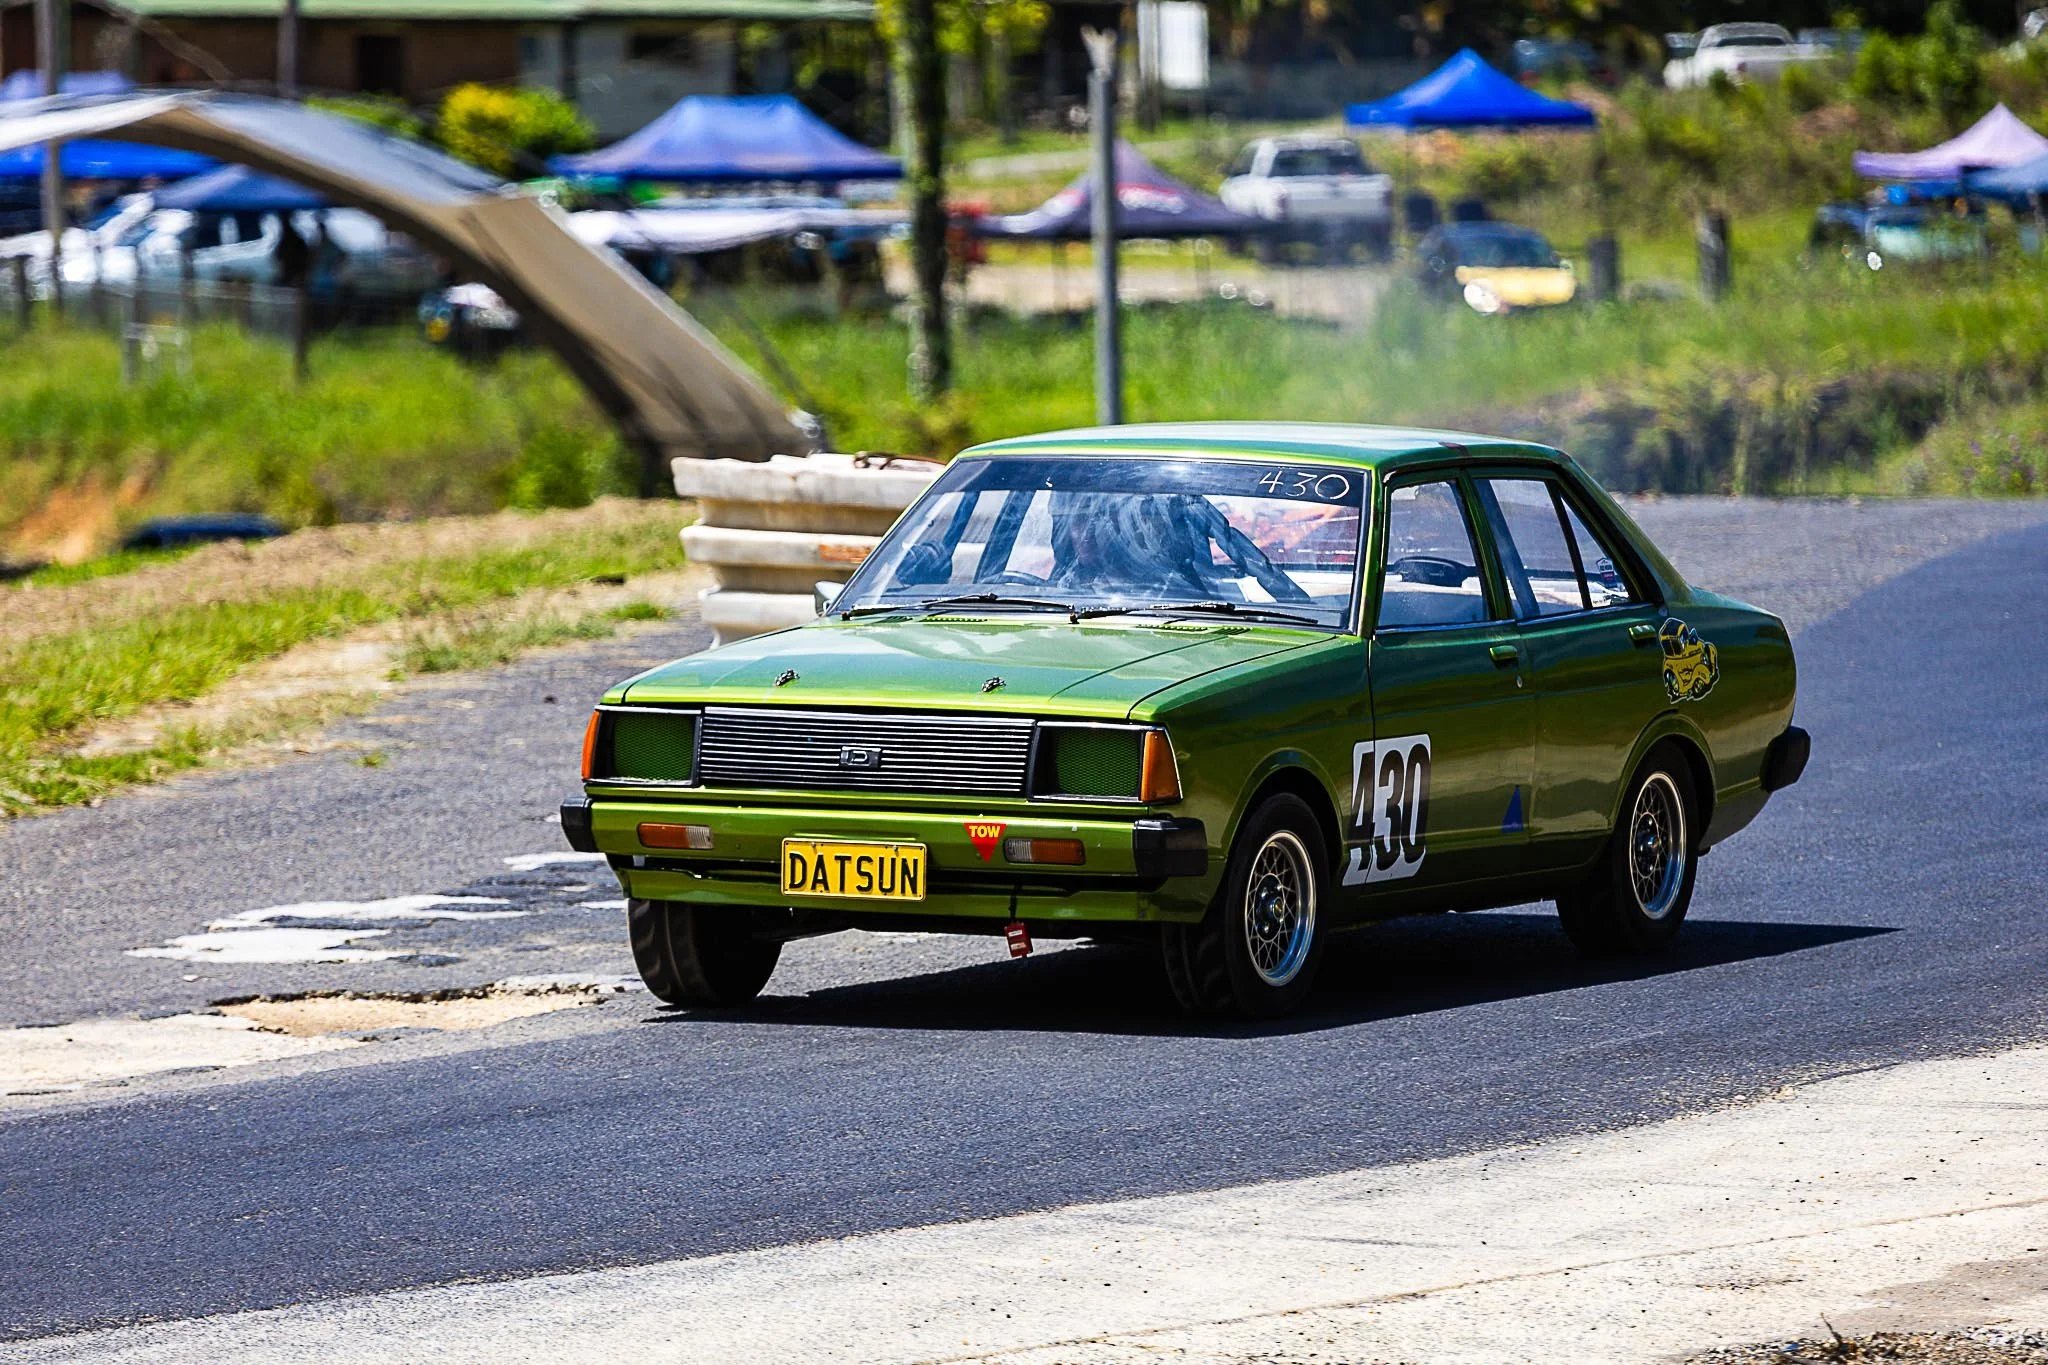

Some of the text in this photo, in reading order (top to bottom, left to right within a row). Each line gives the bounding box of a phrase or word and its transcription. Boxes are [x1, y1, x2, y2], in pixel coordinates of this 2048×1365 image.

[1259, 470, 1350, 500] 430
[1348, 743, 1431, 872] 430
[968, 825, 1001, 838] TOW
[788, 851, 919, 895] DATSUN
